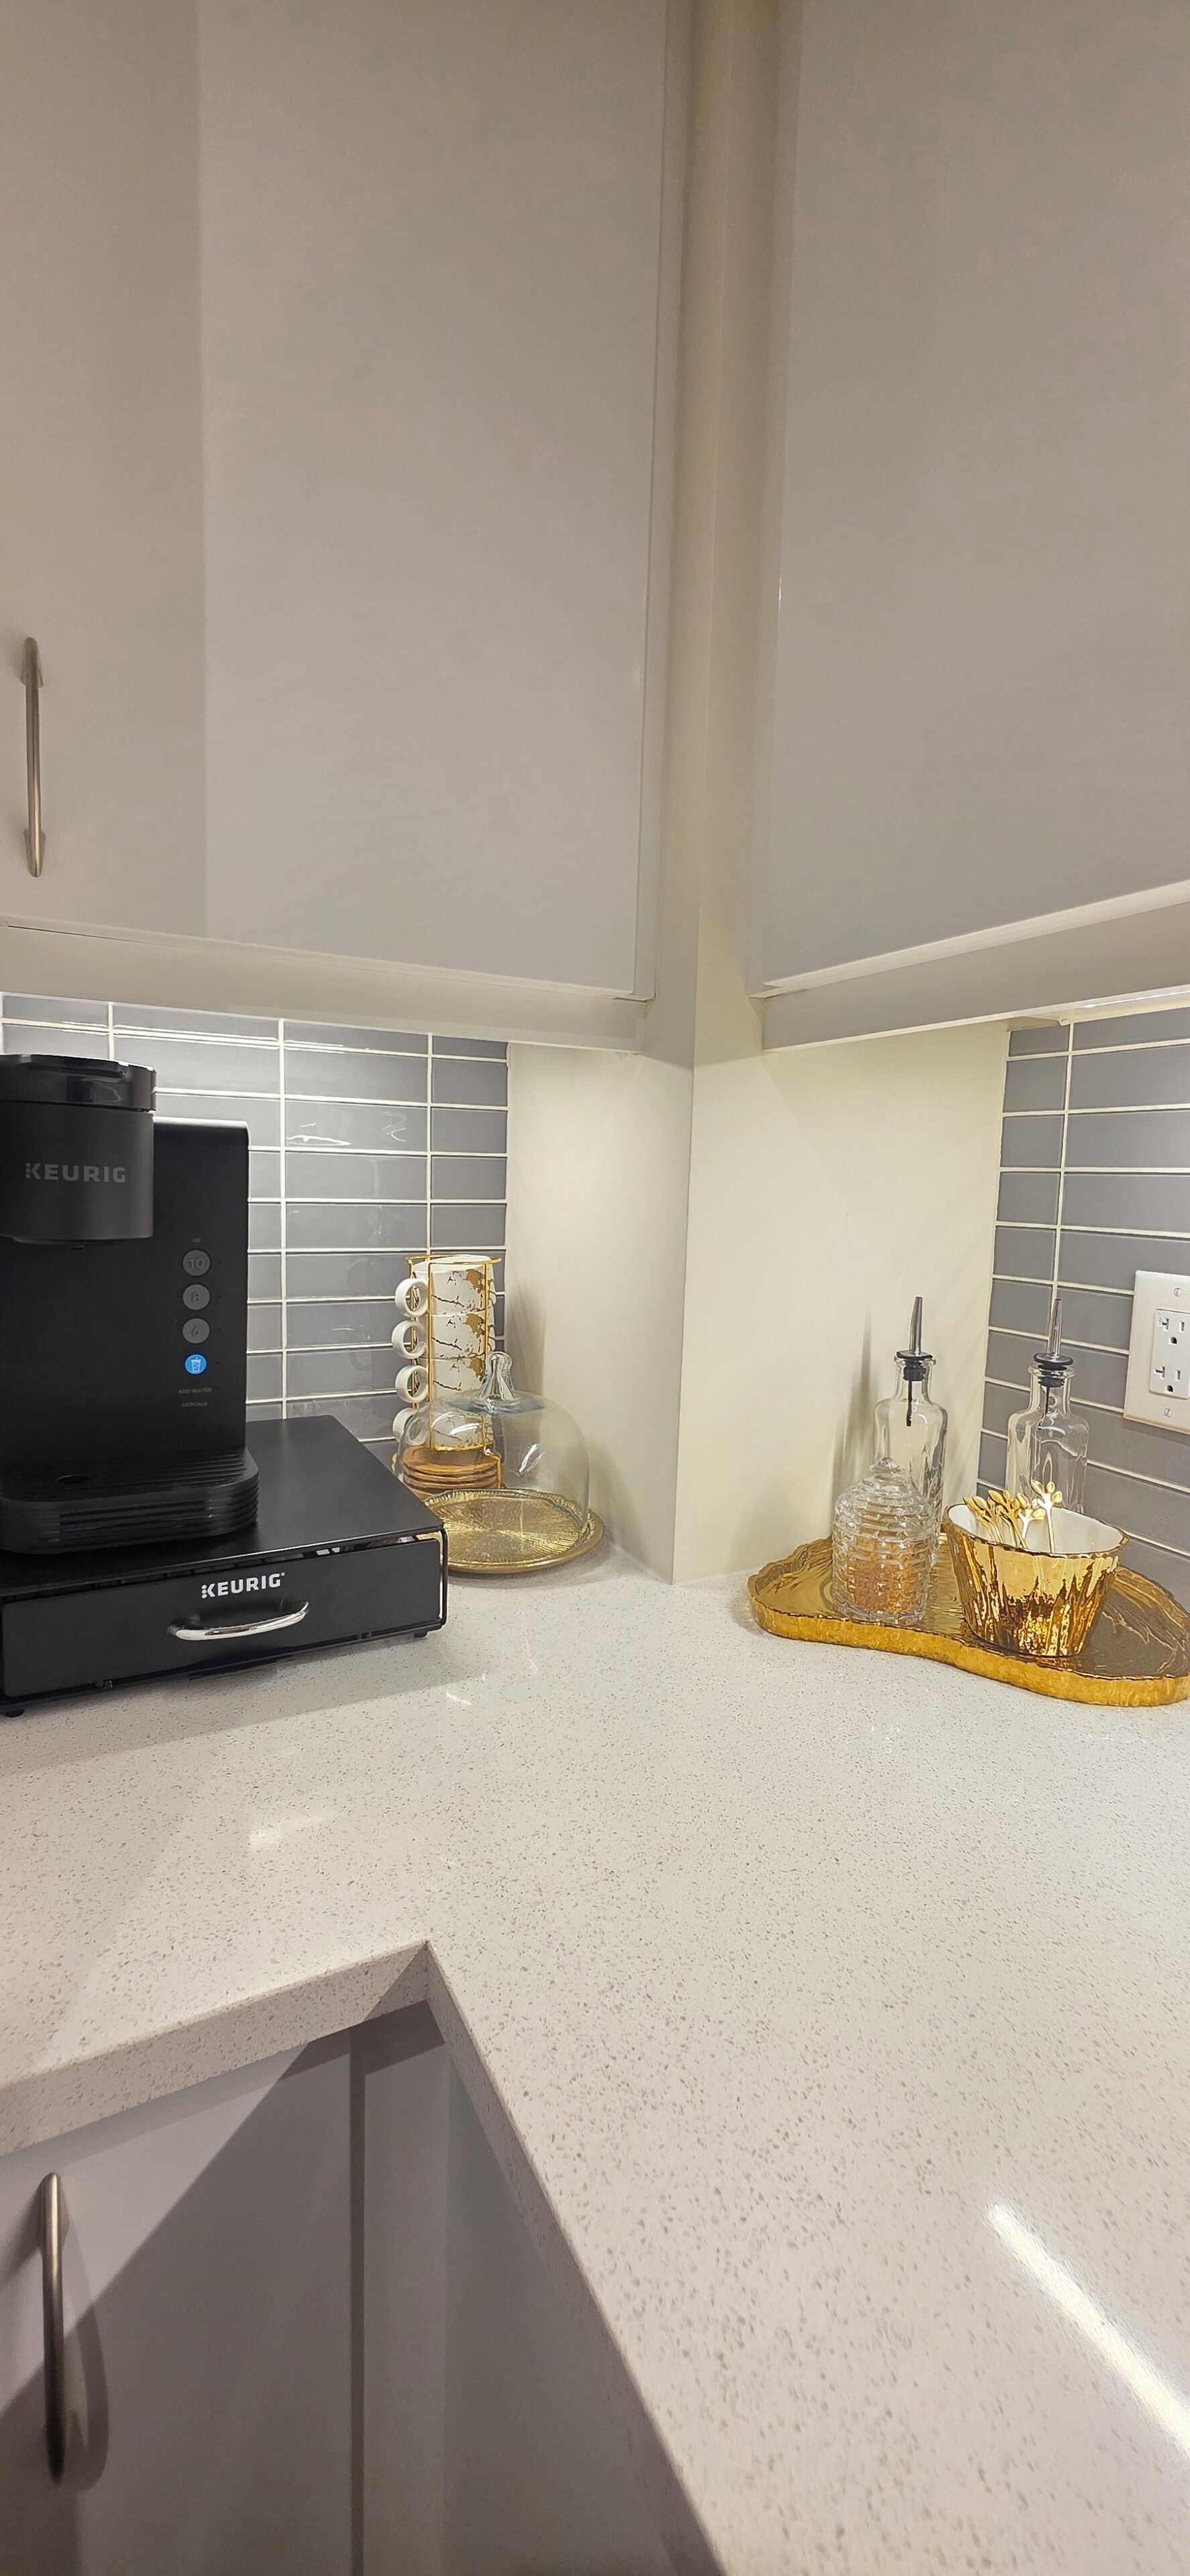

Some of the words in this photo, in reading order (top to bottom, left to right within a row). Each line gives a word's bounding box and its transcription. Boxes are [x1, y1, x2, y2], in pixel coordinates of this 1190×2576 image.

[25, 1162, 126, 1183] KEURIG
[188, 1258, 205, 1269] 10
[191, 1291, 201, 1303] 8
[191, 1325, 201, 1337] 6
[201, 1573, 282, 1599] KEURIG
